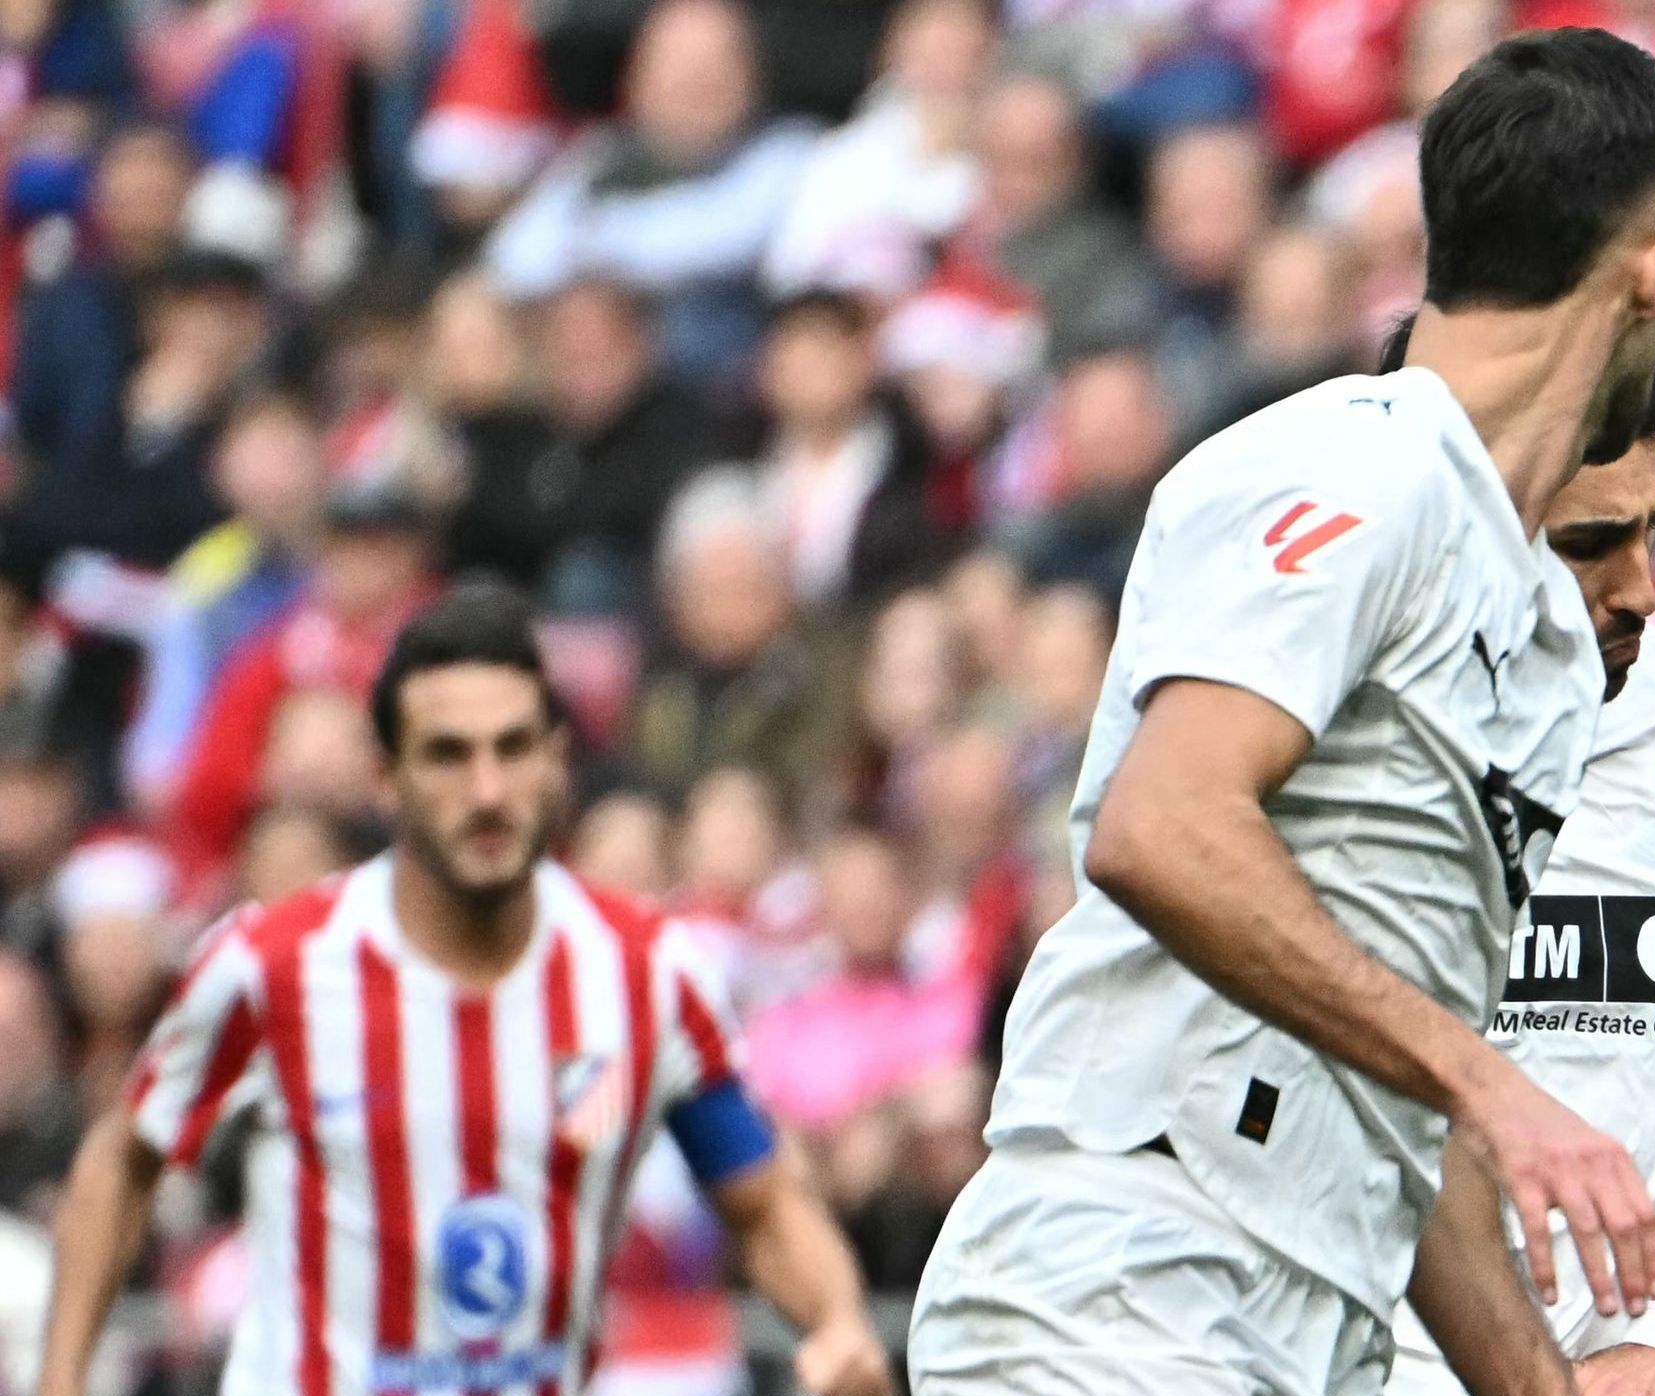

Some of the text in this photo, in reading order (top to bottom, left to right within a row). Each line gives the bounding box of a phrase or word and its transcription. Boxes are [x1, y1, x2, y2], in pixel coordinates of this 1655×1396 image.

[1508, 924, 1581, 980] TM
[1492, 1011, 1519, 1034] M
[1519, 1009, 1570, 1031] Real
[1574, 1011, 1647, 1036] Estate
